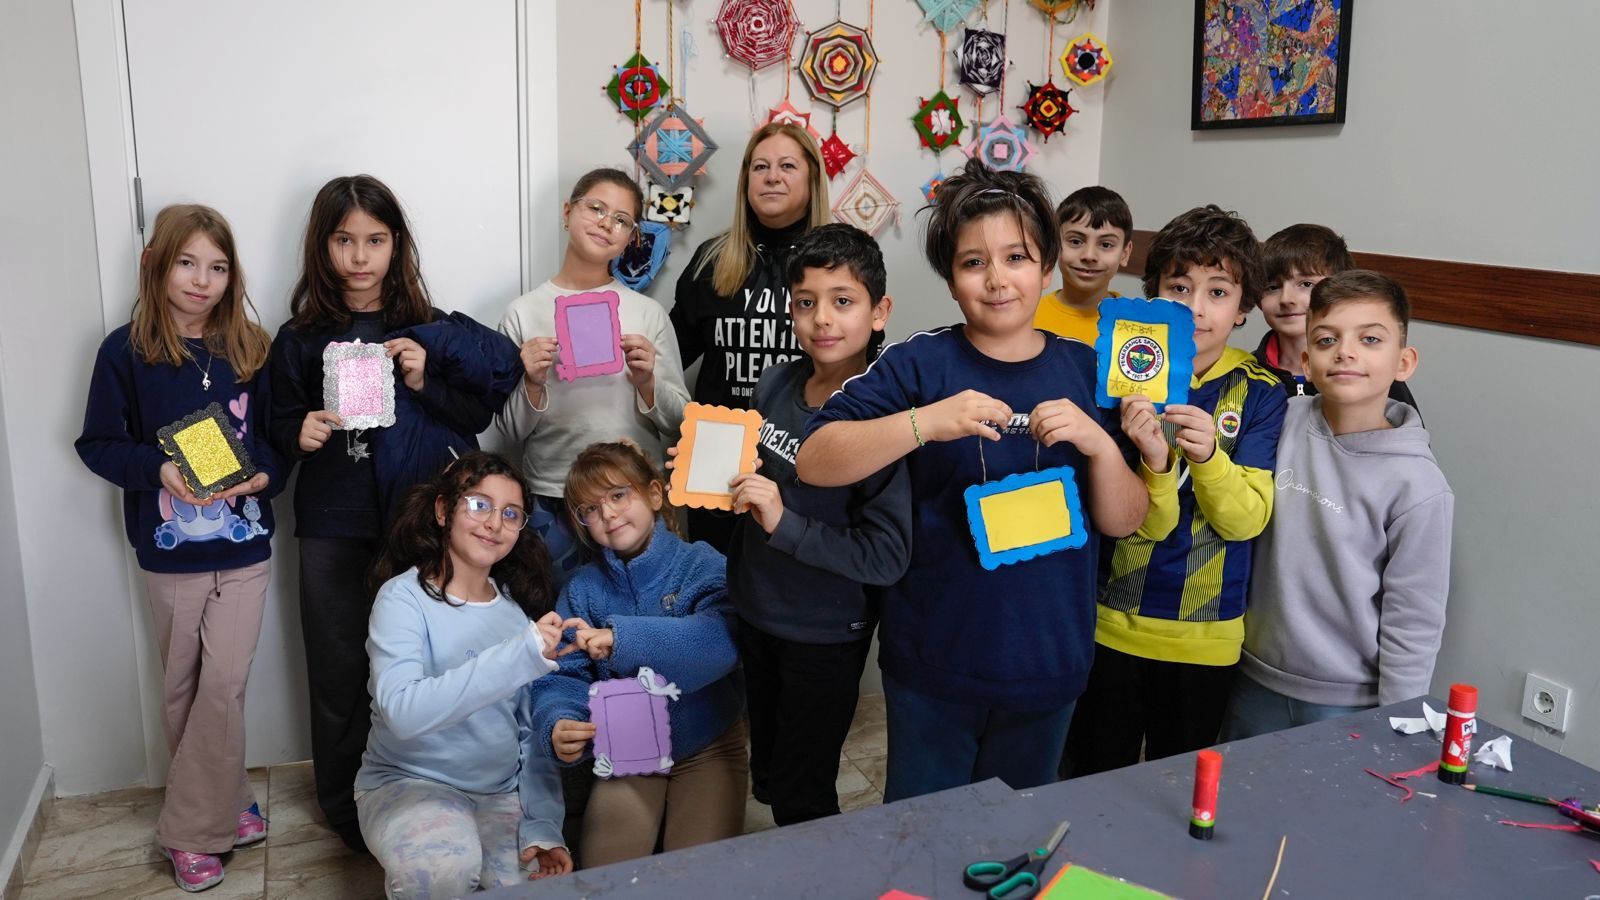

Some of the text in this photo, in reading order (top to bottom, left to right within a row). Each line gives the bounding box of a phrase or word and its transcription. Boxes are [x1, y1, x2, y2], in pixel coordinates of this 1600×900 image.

[714, 317, 804, 351] ATTENTI
[725, 351, 803, 383] PLEA
[731, 386, 740, 396] NO
